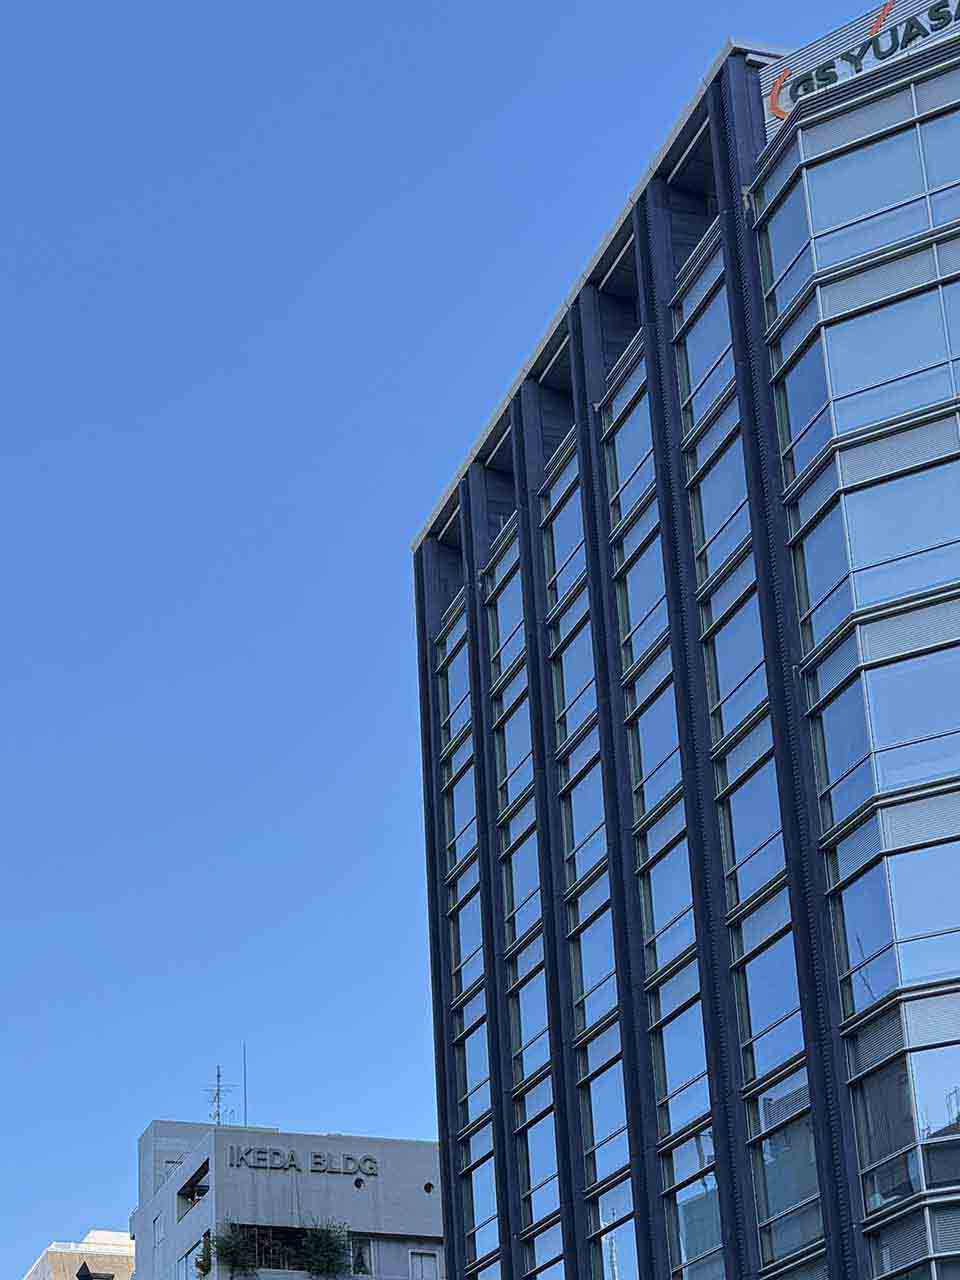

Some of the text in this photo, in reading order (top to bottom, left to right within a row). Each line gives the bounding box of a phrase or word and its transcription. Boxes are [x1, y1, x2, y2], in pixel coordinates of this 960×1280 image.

[840, 0, 960, 74] YUAS
[228, 1145, 379, 1177] IKEDA BLDG
